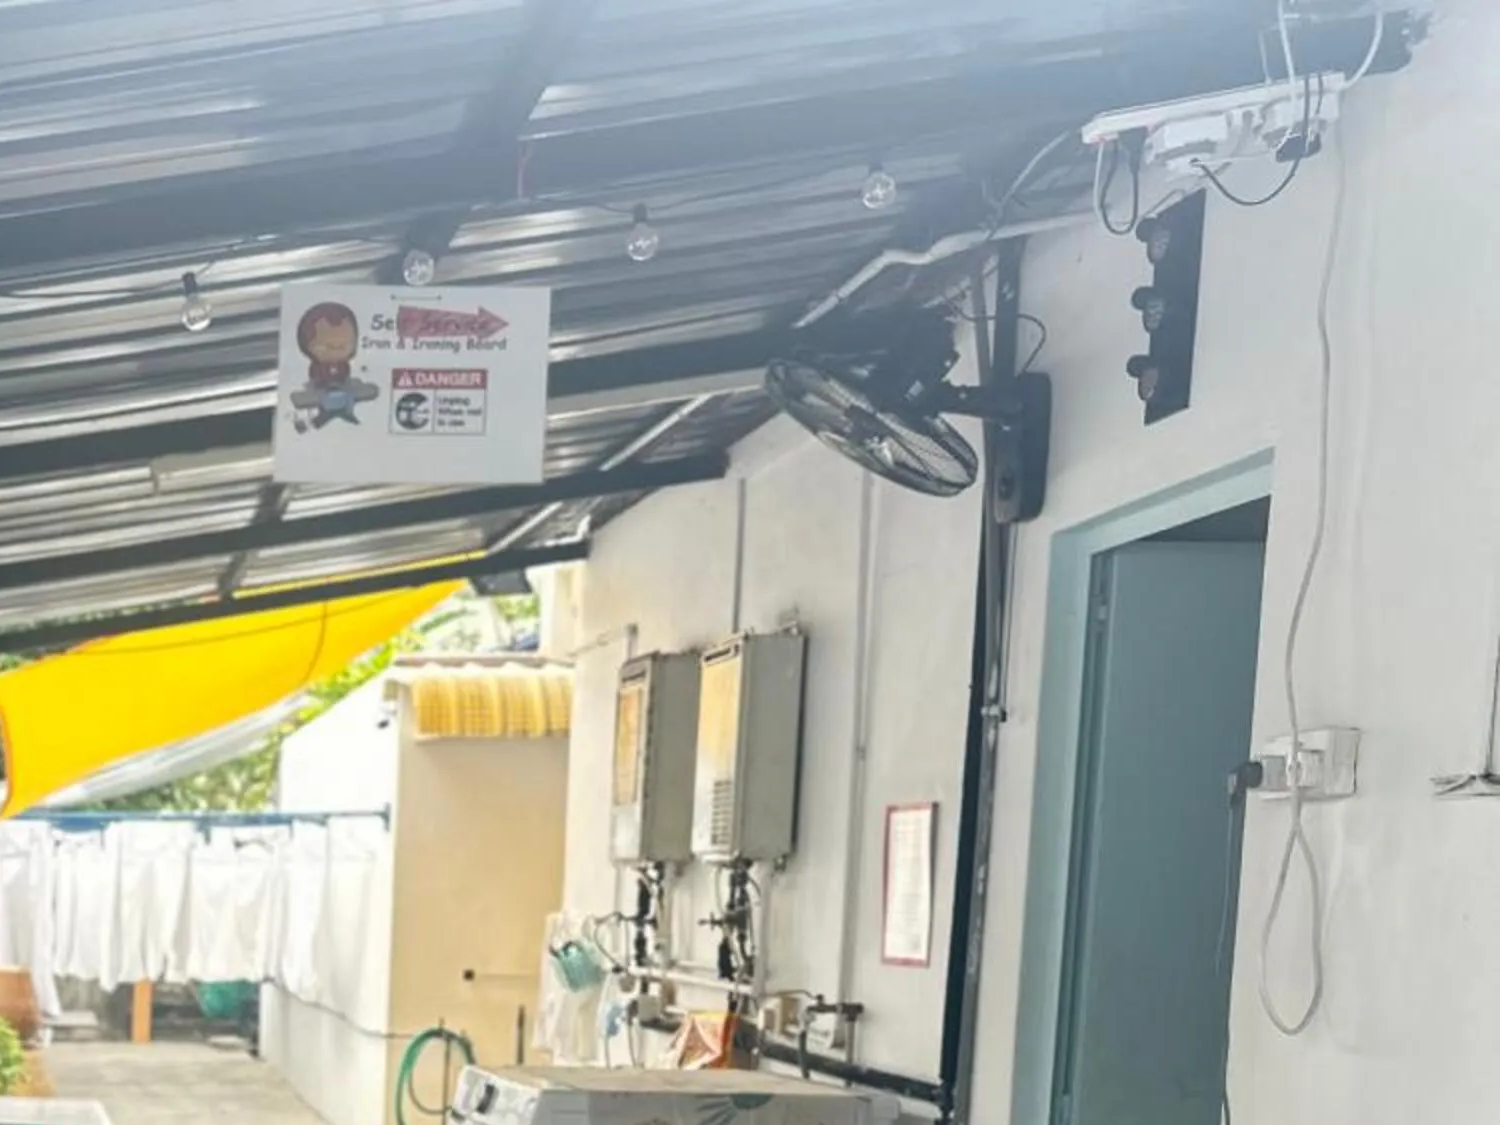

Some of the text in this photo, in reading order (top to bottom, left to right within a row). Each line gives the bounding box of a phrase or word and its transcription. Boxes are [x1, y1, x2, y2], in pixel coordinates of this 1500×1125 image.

[361, 335, 391, 349] Iron
[412, 336, 460, 353] Ironing
[415, 371, 482, 386] DANGER
